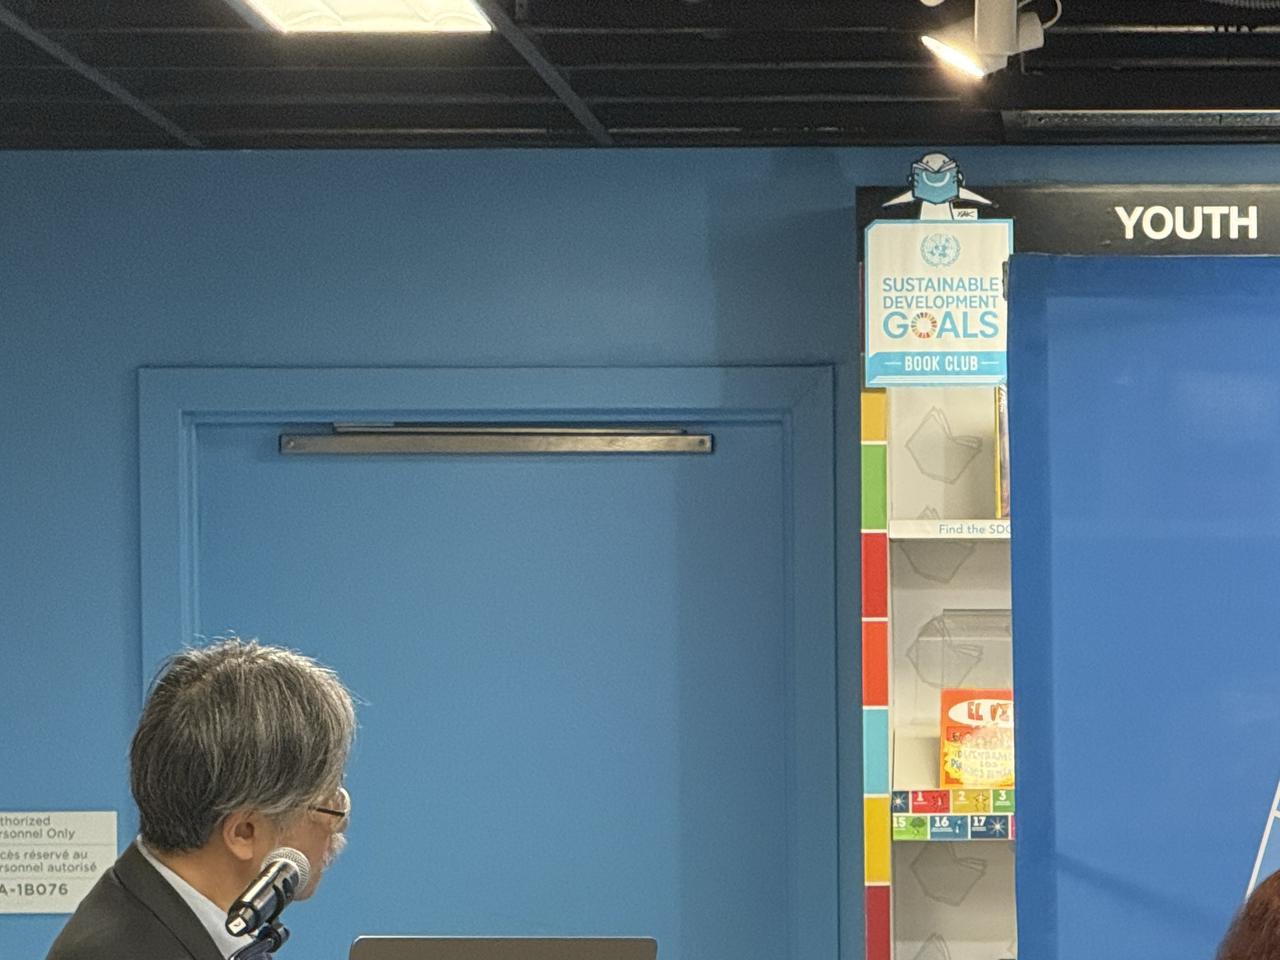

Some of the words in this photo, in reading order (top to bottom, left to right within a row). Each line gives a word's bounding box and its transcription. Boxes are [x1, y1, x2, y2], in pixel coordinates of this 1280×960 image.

[1115, 206, 1258, 240] YOUTH
[882, 277, 999, 292] SUSTAINABLE
[883, 295, 999, 309] DEVELOPMENT
[883, 310, 999, 339] GOALS
[904, 356, 940, 371] BOOK
[945, 356, 978, 371] CLUB
[938, 524, 963, 534] Find
[967, 524, 985, 534] the
[916, 791, 924, 801] 1
[958, 790, 966, 800] 2
[998, 790, 1007, 801] 3
[893, 816, 906, 827] 15
[934, 816, 949, 827] 16
[973, 816, 986, 826] 17
[47, 828, 75, 840] Only
[24, 849, 69, 860] réservé
[73, 851, 88, 860] au
[48, 862, 97, 873] autorisé
[0, 883, 68, 896] A-1B076
